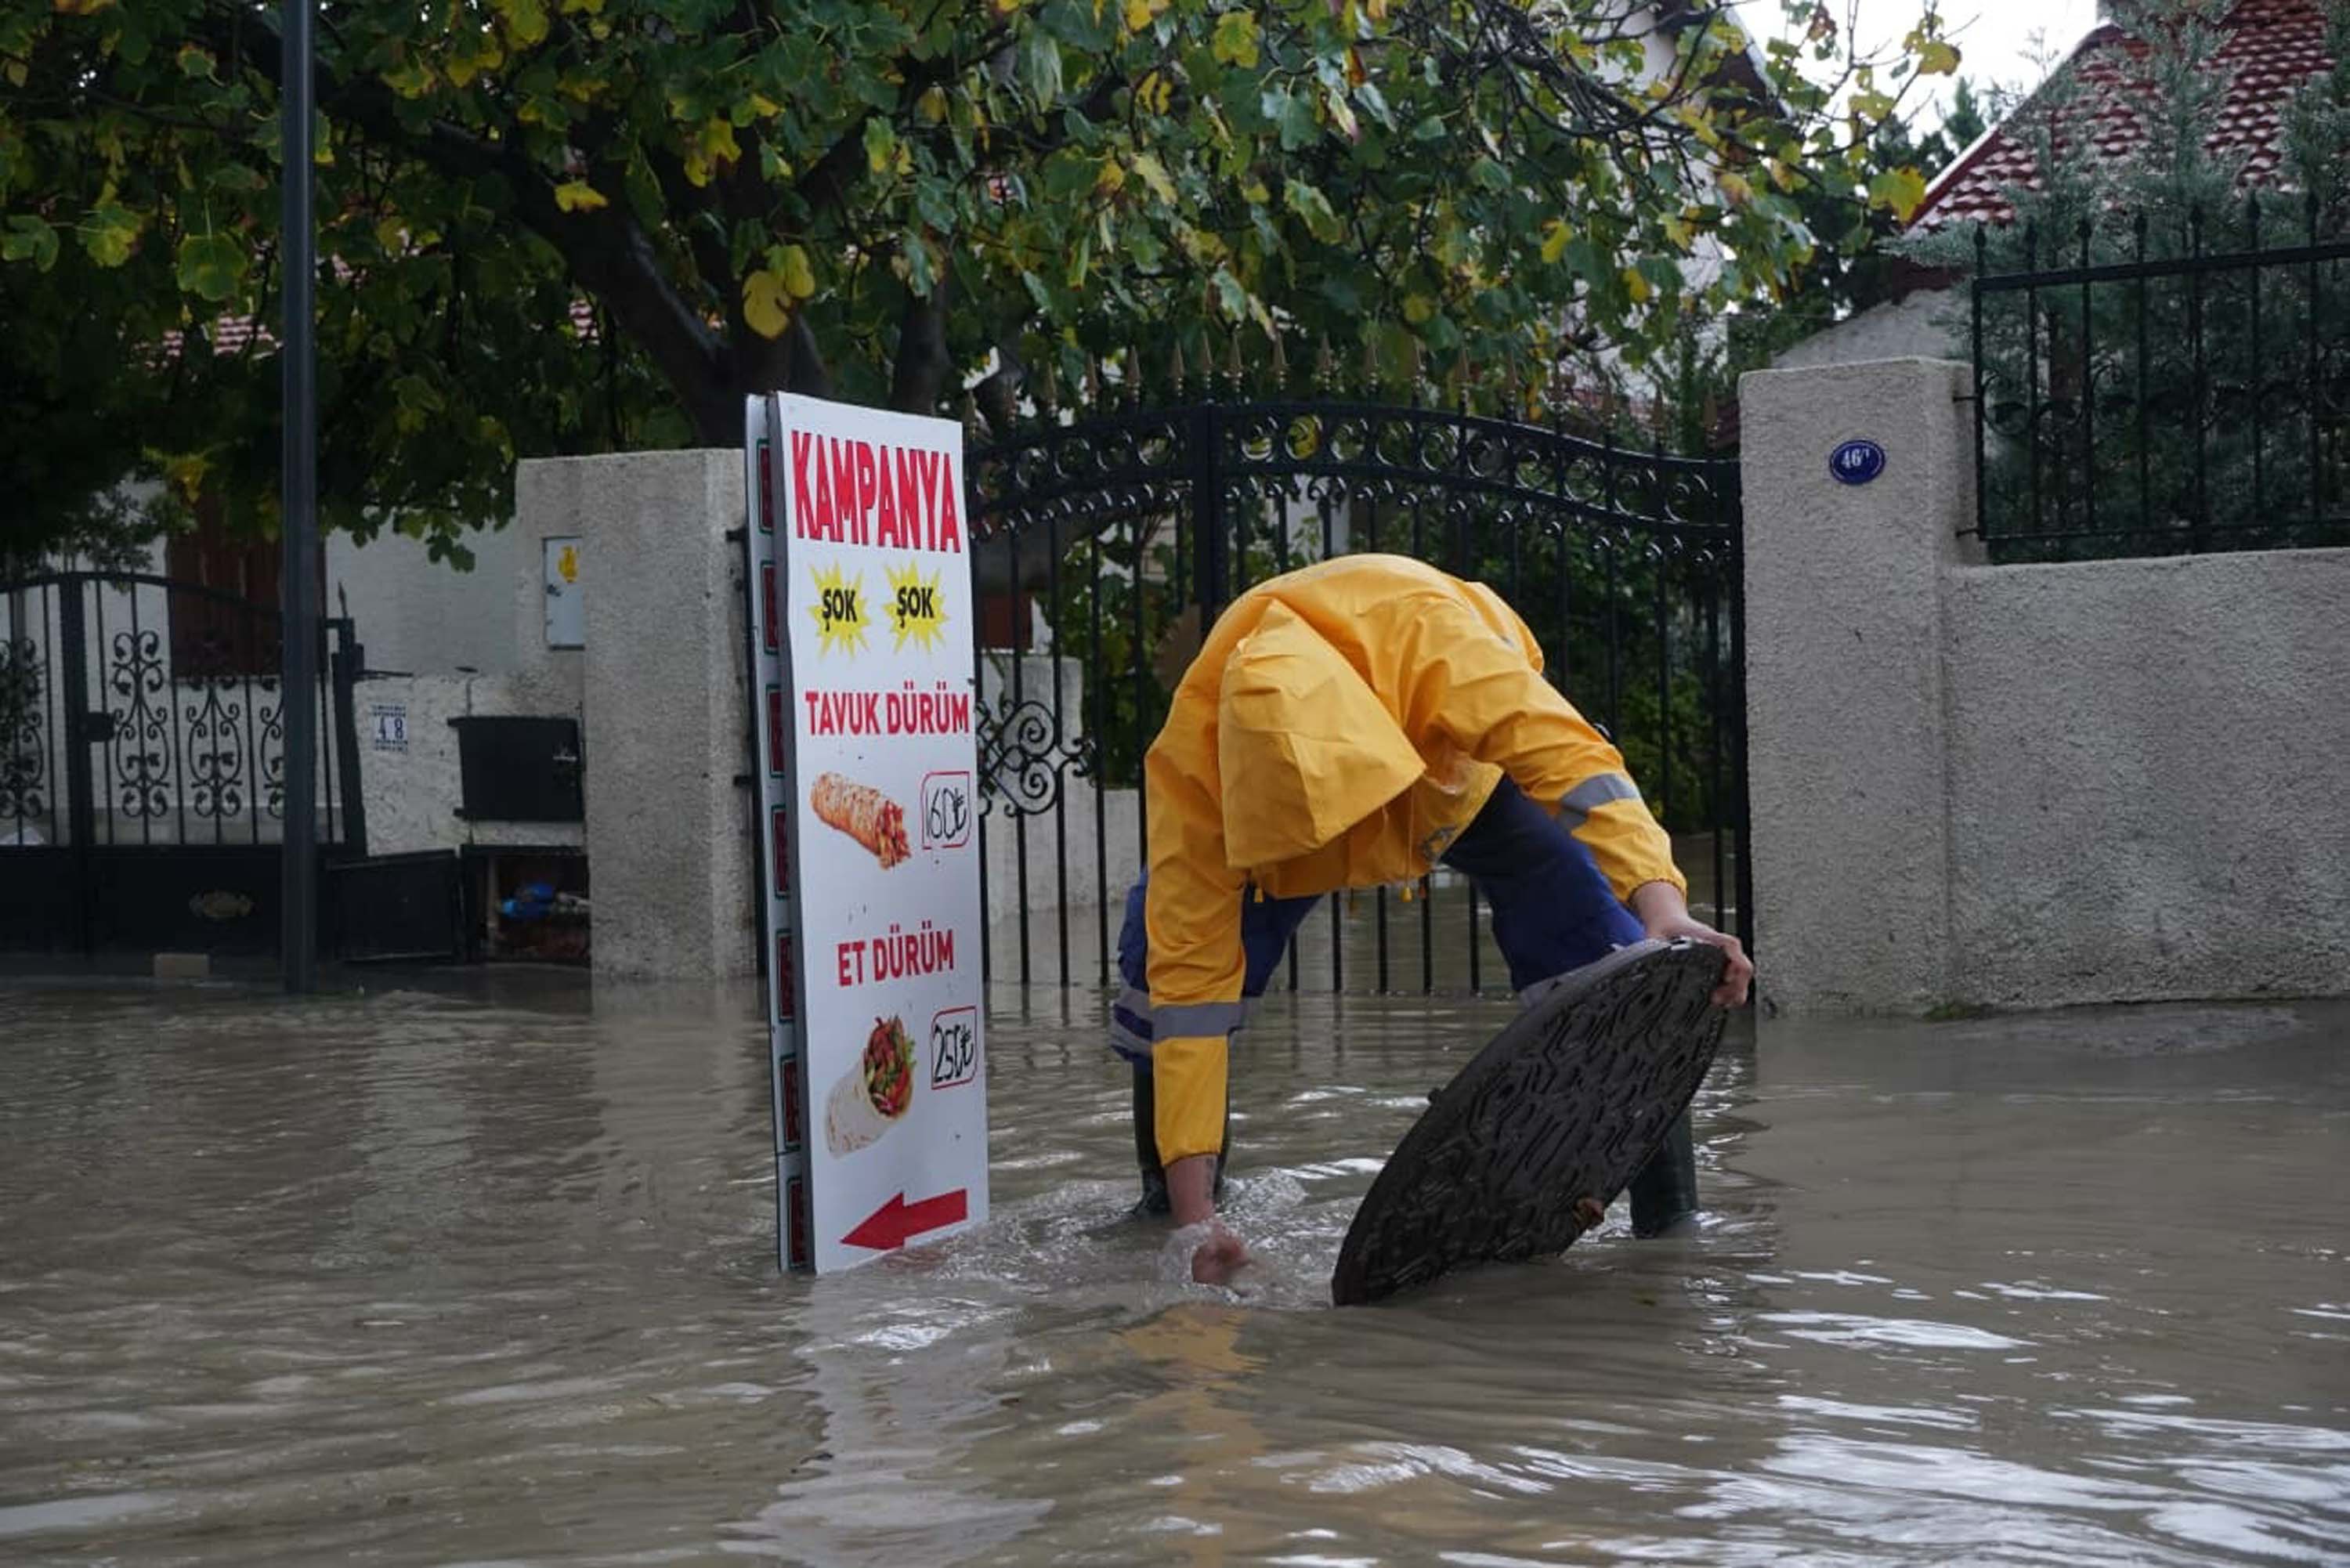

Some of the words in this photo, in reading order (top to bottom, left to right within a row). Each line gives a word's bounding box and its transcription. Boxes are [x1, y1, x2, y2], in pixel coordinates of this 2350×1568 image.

[791, 431, 961, 553] KAMPANYA
[822, 588, 857, 631] ŞOK
[897, 586, 934, 629] ŞOK
[804, 690, 880, 735] TAVUK
[886, 680, 970, 735] DÜRÜM
[837, 940, 866, 987] ET
[873, 920, 954, 982] DÜRÜM
